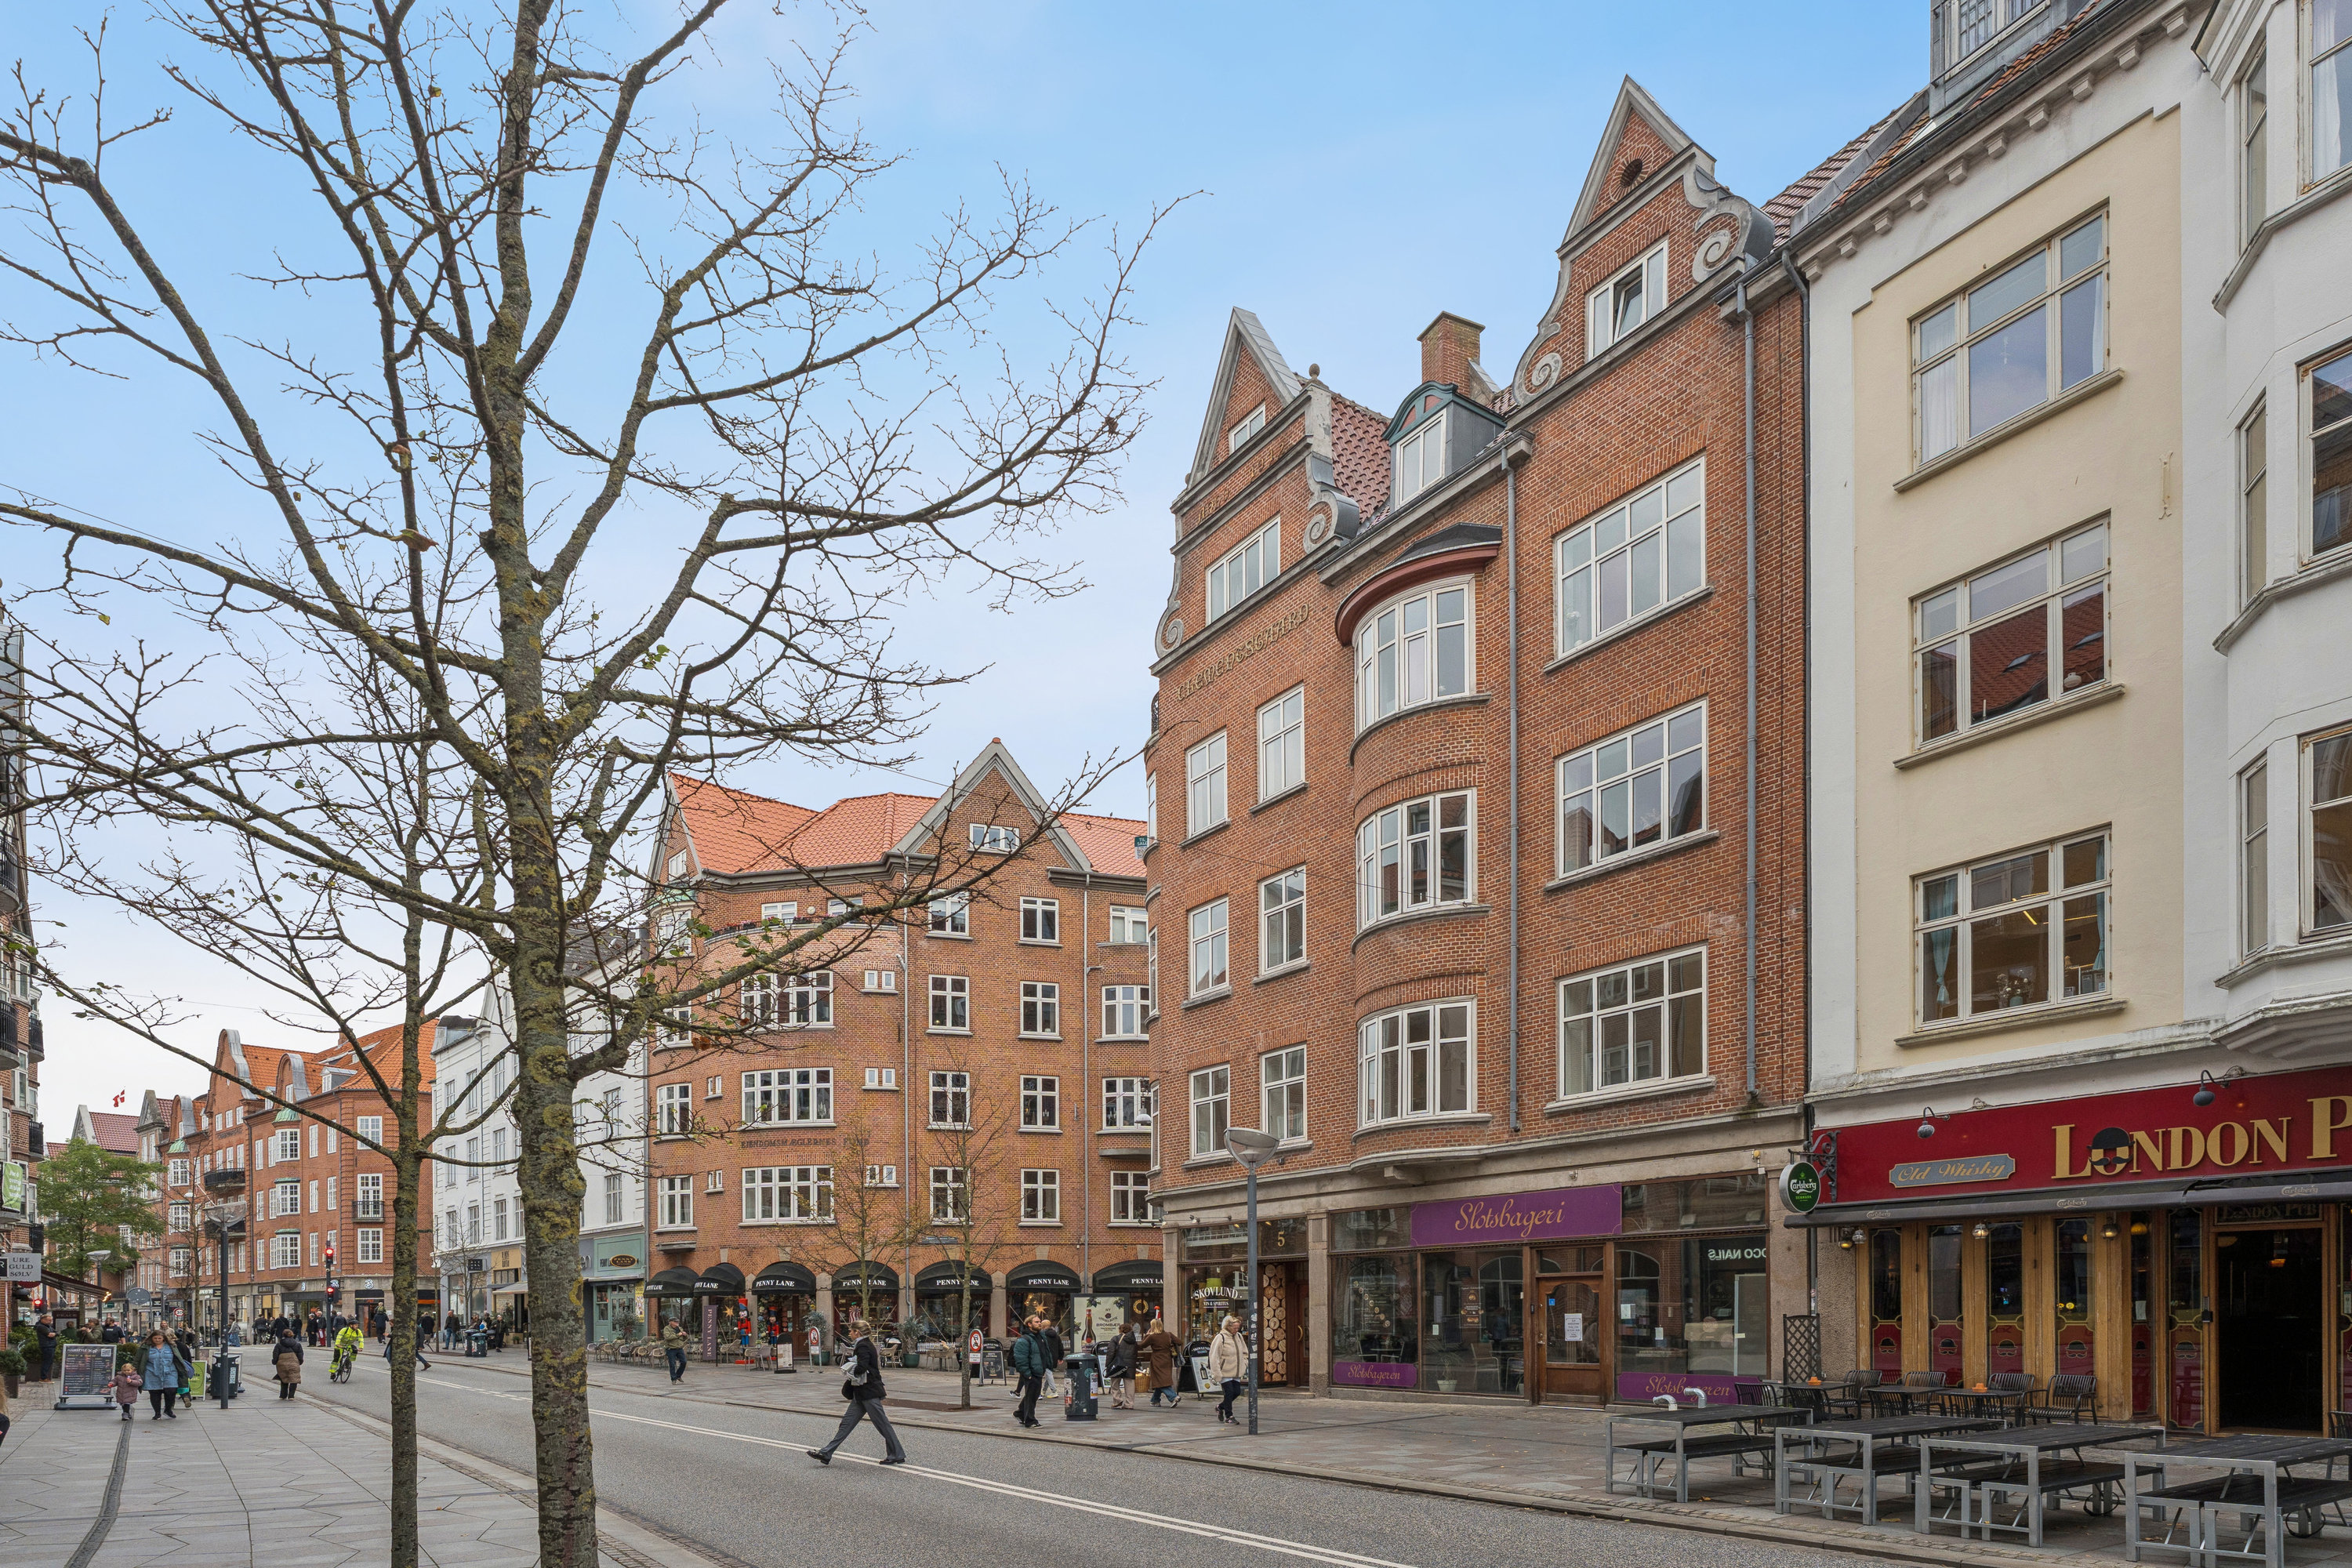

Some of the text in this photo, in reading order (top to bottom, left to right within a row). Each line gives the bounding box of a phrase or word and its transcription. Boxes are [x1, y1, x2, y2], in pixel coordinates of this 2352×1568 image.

[2051, 1116, 2292, 1179] LONDON
[1897, 1161, 2005, 1182] Old Whisky
[1790, 1178, 1817, 1193] Carlsberg
[2281, 1185, 2318, 1197] Carlsberg
[2056, 1198, 2087, 1209] Carlsberg
[1455, 1199, 1565, 1238] Slotsbageri
[1866, 1210, 1891, 1220] Carlsberg
[1278, 1231, 1285, 1247] 5
[1194, 1287, 1238, 1300] SKOVLUND
[1348, 1364, 1400, 1385] Slotsbageren
